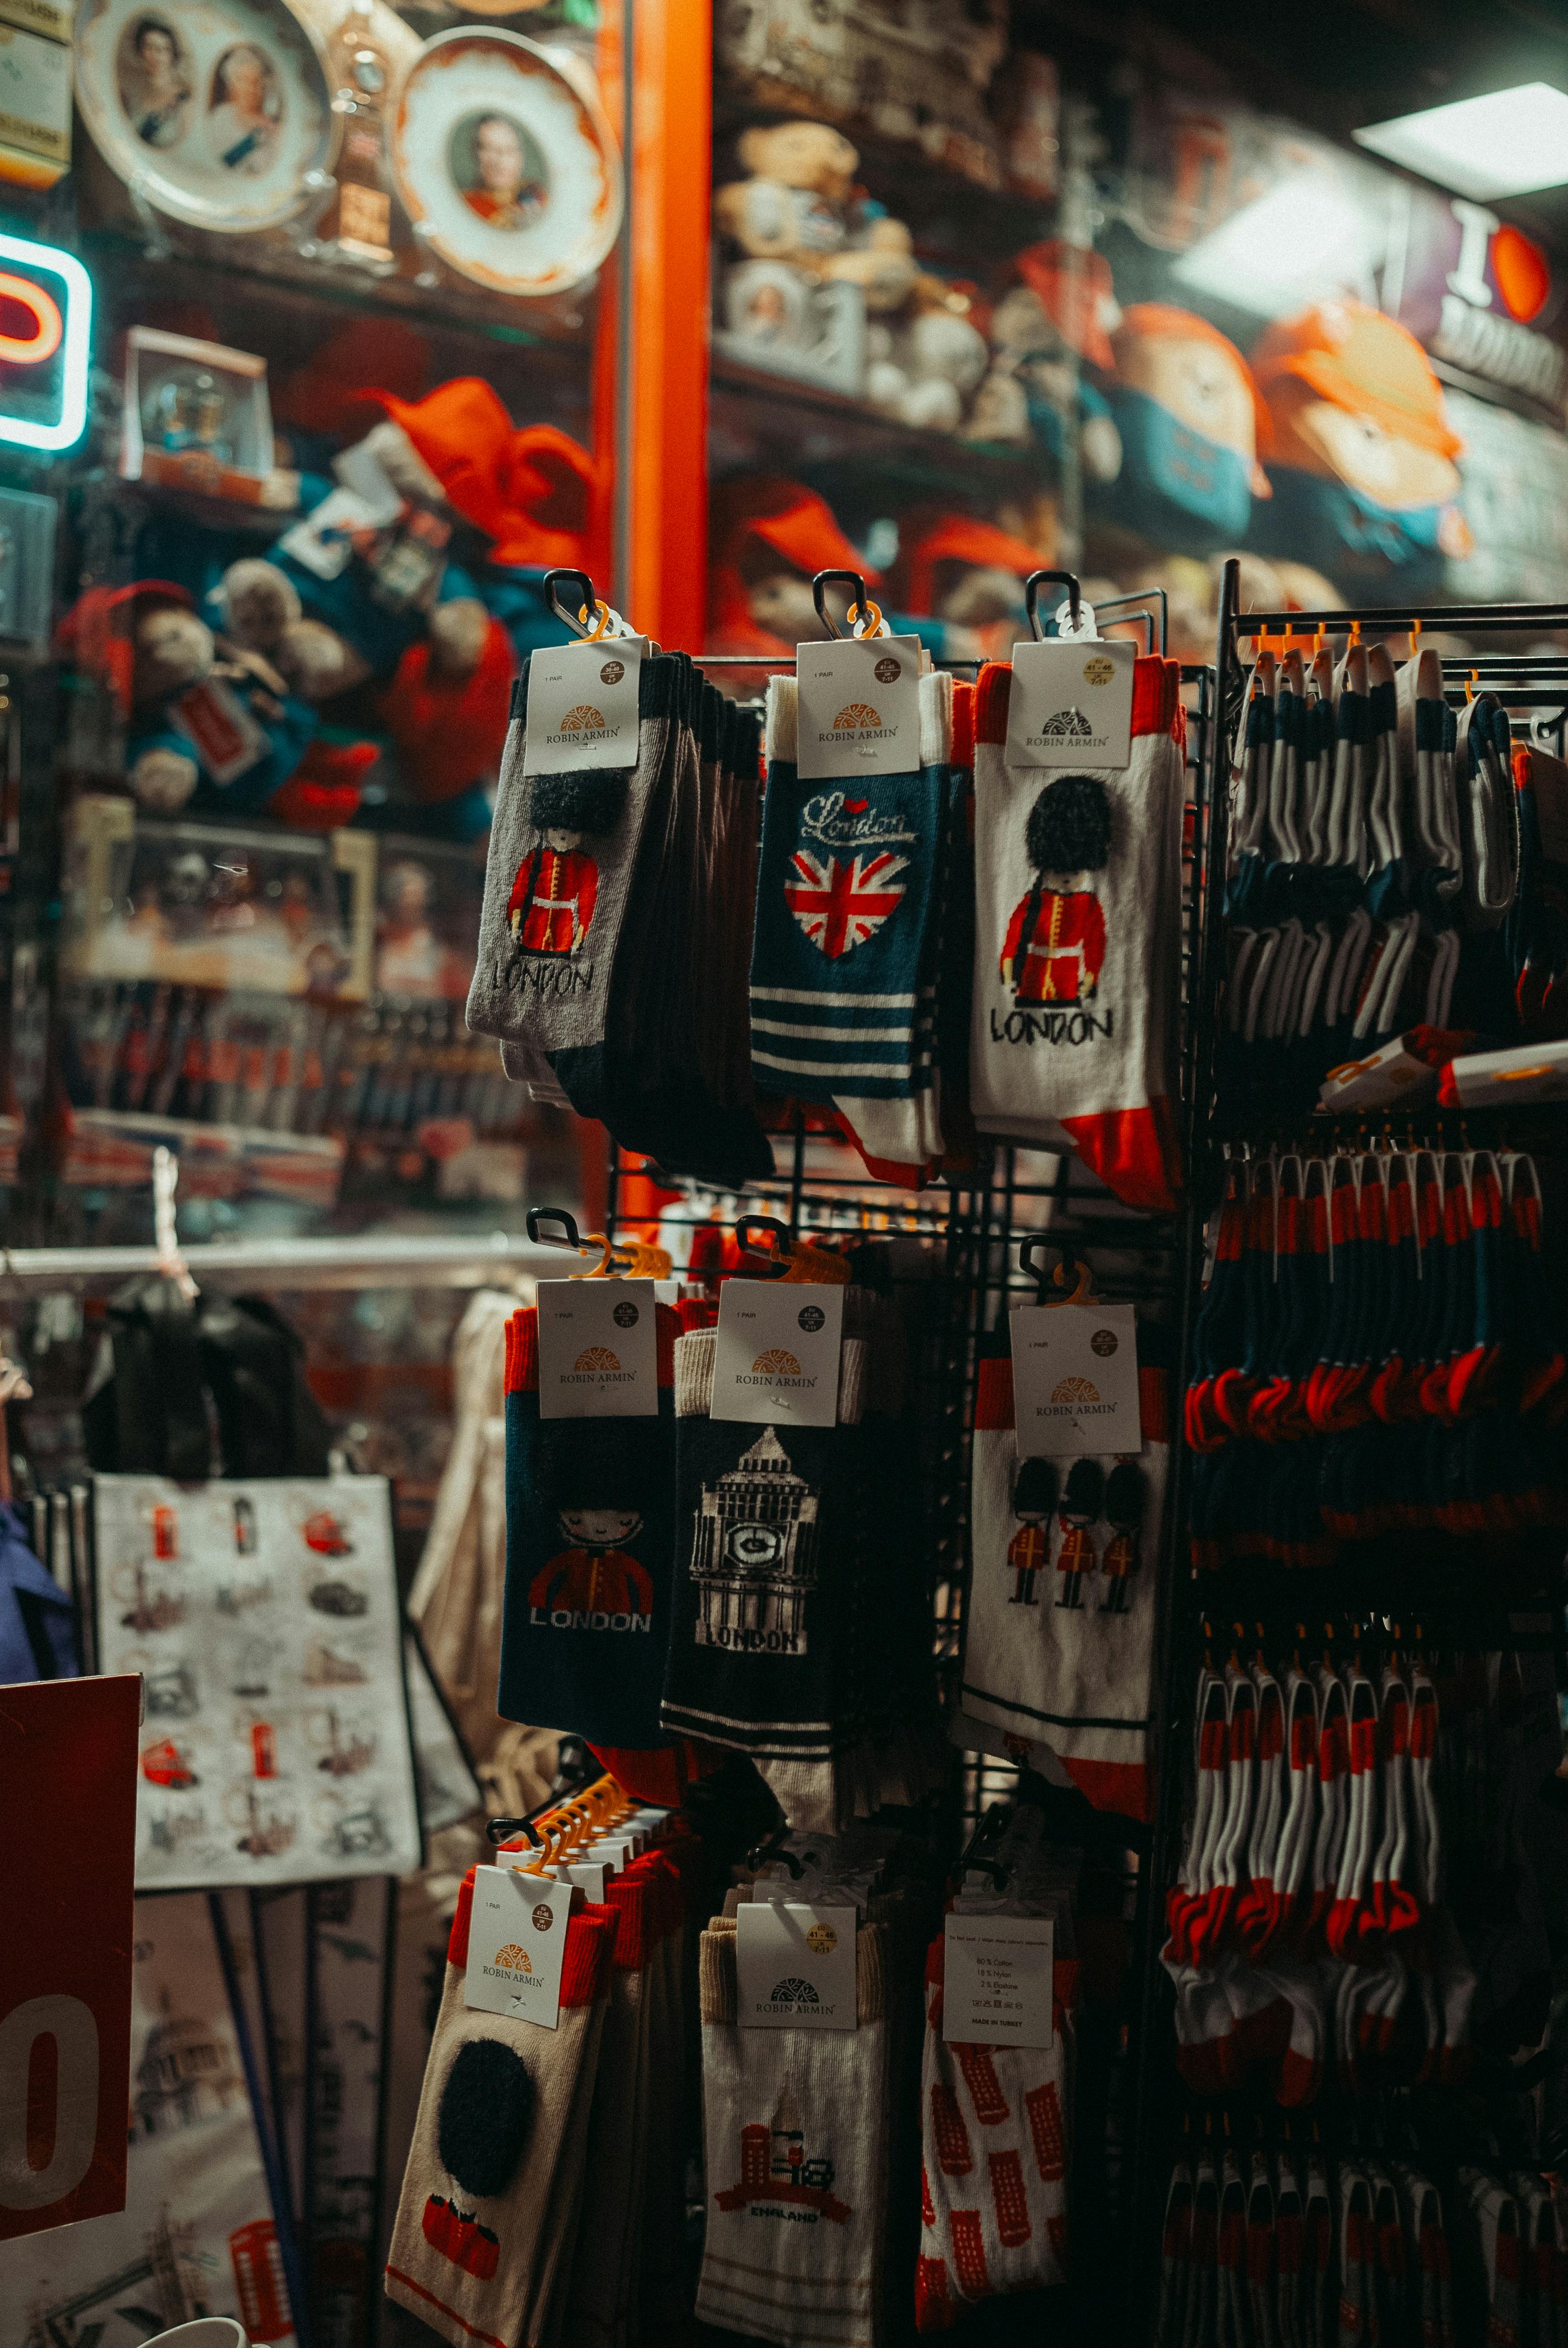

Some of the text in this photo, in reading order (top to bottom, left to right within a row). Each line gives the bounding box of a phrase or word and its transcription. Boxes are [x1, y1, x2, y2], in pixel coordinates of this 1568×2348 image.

[546, 728, 618, 744] ROBIN ARMIN
[818, 728, 896, 742] ROBIN ARMIN
[1027, 738, 1107, 747] ROBIN ARMIN
[801, 791, 919, 847] London
[493, 959, 595, 997] LONDON
[991, 1008, 1113, 1046] LONDON
[560, 1373, 635, 1383] ROBIN ARMIN
[736, 1375, 815, 1387] ROBIN ARMIN
[1036, 1404, 1116, 1416] ROBIN ARMIN
[530, 1607, 652, 1632] LONDON
[706, 1623, 798, 1651] LONDON
[483, 1966, 542, 1987] ROBIN ARMIN
[993, 1981, 1018, 1990] Elastane
[756, 2004, 834, 2014] ROBIN ARMIN
[751, 2207, 818, 2223] ENGLAND
